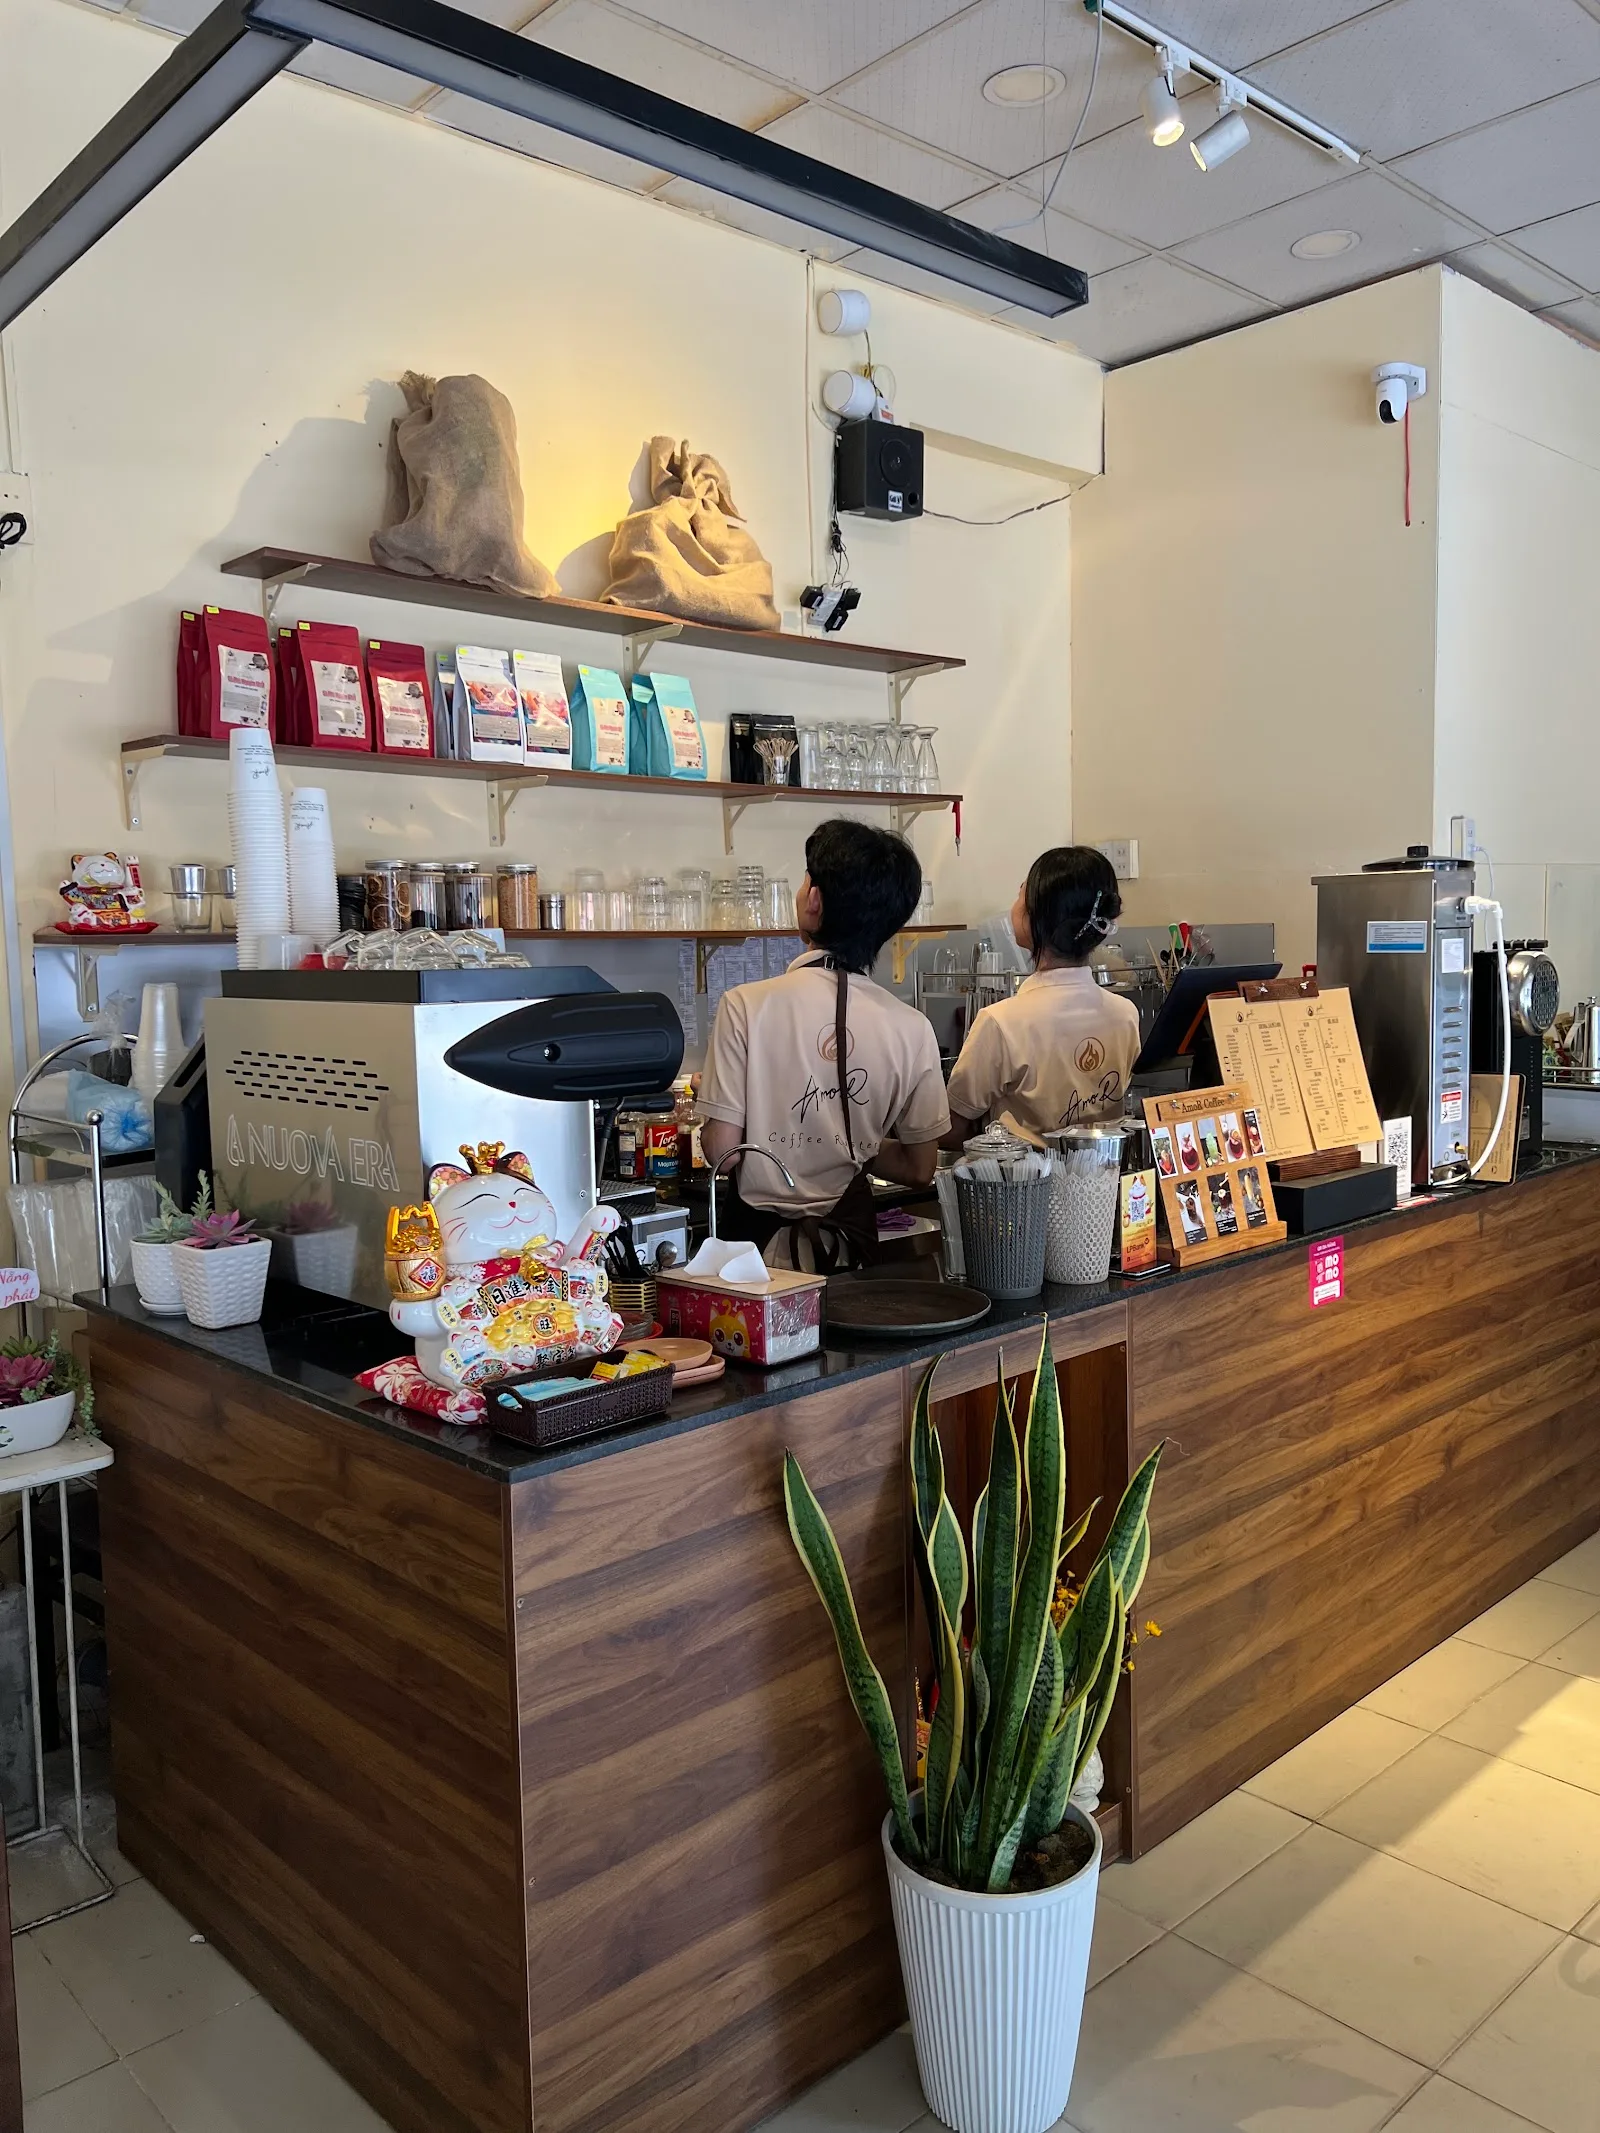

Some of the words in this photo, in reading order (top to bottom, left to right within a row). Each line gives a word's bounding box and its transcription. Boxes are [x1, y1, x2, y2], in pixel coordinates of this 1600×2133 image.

[1204, 1097, 1225, 1109] Coffee
[769, 1132, 822, 1149] Coffee
[248, 1123, 345, 1182] NUOVA
[349, 1138, 400, 1192] ERA
[421, 1265, 437, 1281] 福
[540, 1318, 552, 1330] 旺
